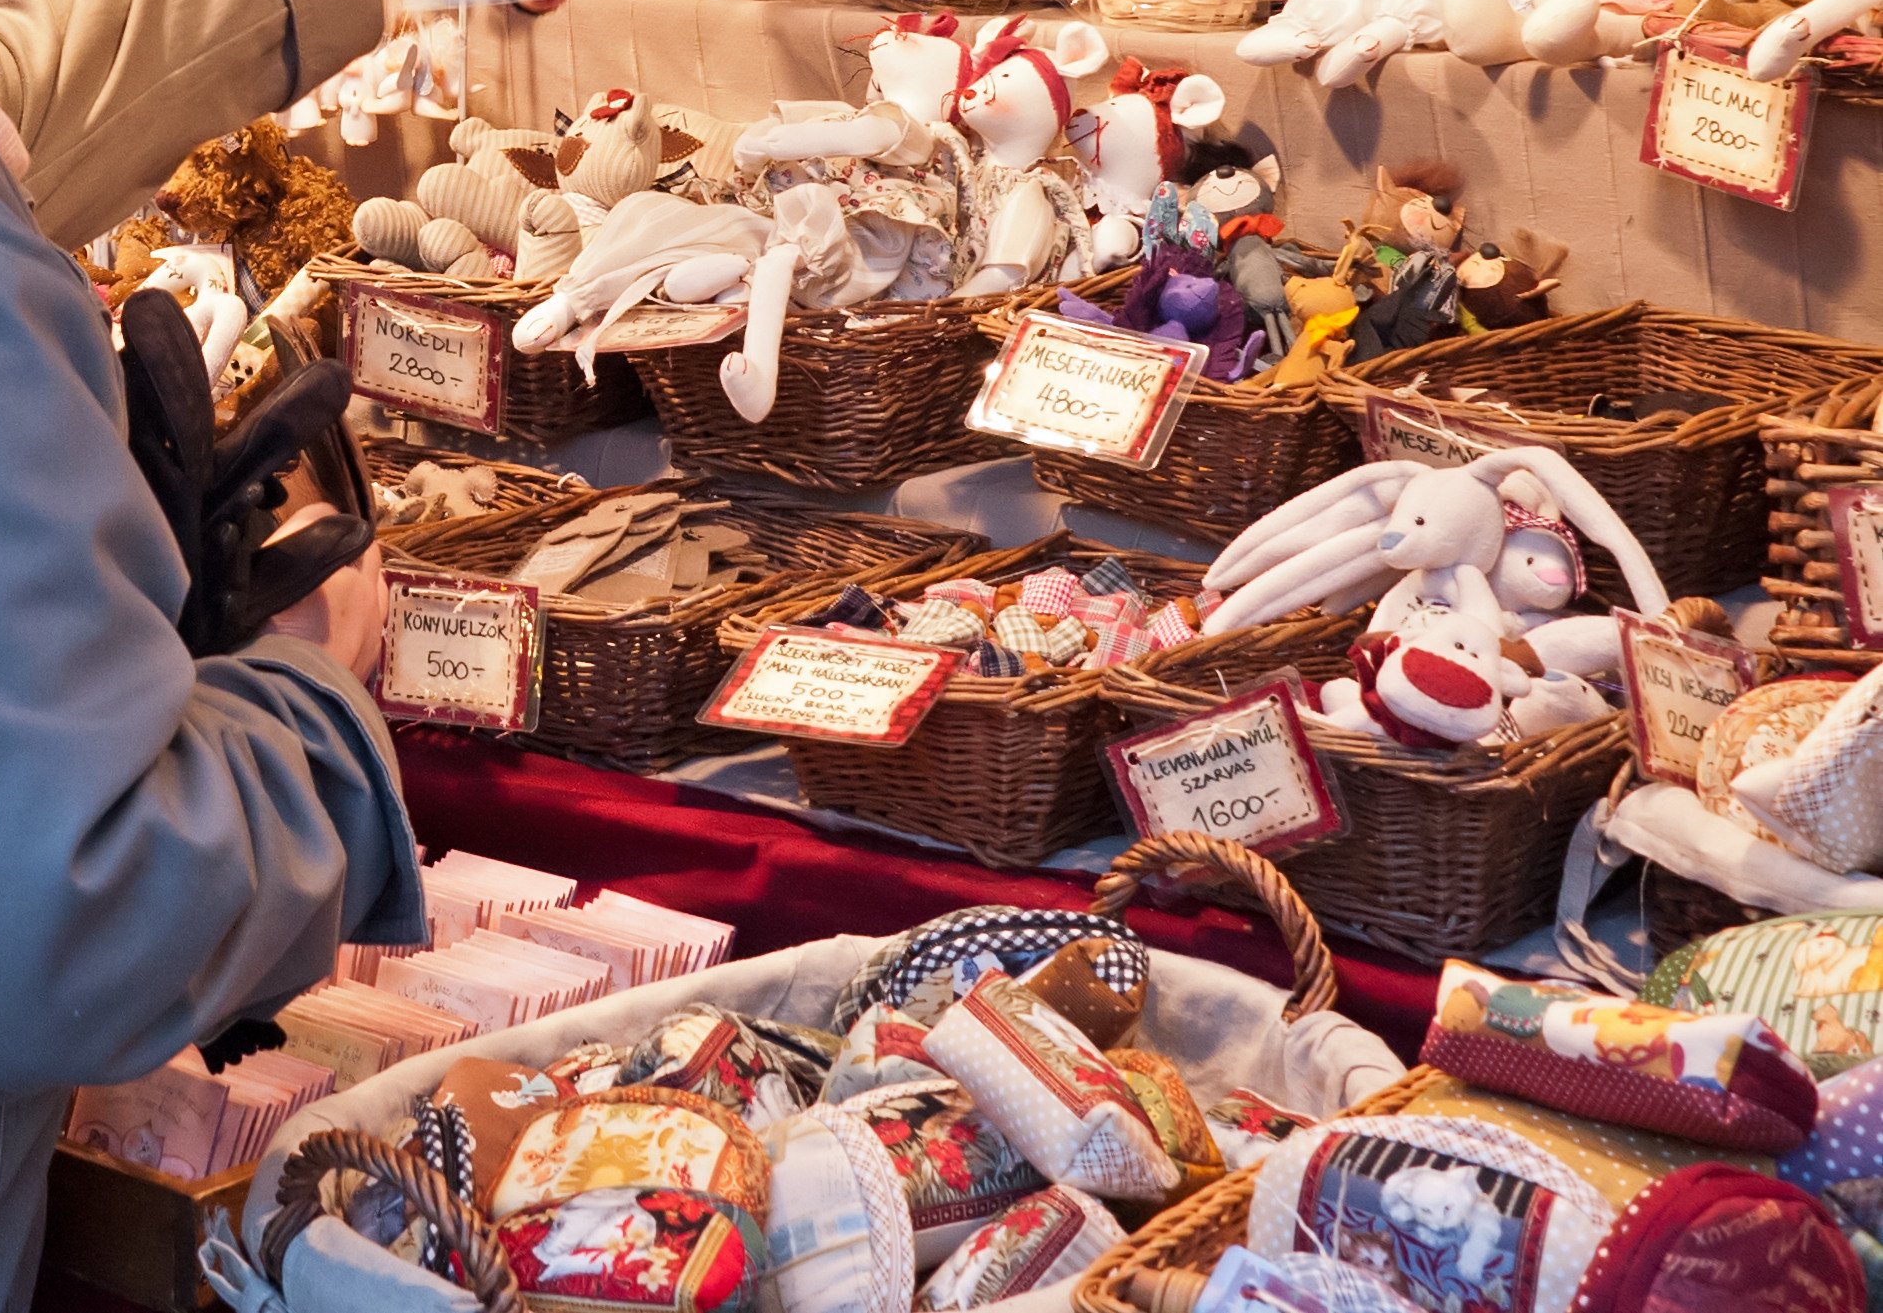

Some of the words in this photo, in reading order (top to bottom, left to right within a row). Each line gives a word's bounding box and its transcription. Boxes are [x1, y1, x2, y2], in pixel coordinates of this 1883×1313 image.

[1682, 76, 1723, 105] FILC
[1726, 91, 1772, 123] MACI
[375, 316, 463, 358] NOKEDLI
[1389, 426, 1443, 456] MESE
[403, 607, 509, 641] KÖNYVJELZŐK
[769, 660, 803, 676] MACI
[742, 702, 816, 720] SLEEPING
[823, 713, 859, 725] BAG
[746, 690, 792, 704] LUCKY
[803, 699, 848, 713] BEAR
[856, 706, 875, 716] IN
[1667, 709, 1708, 742] 220
[1180, 758, 1256, 794] SZARVAS
